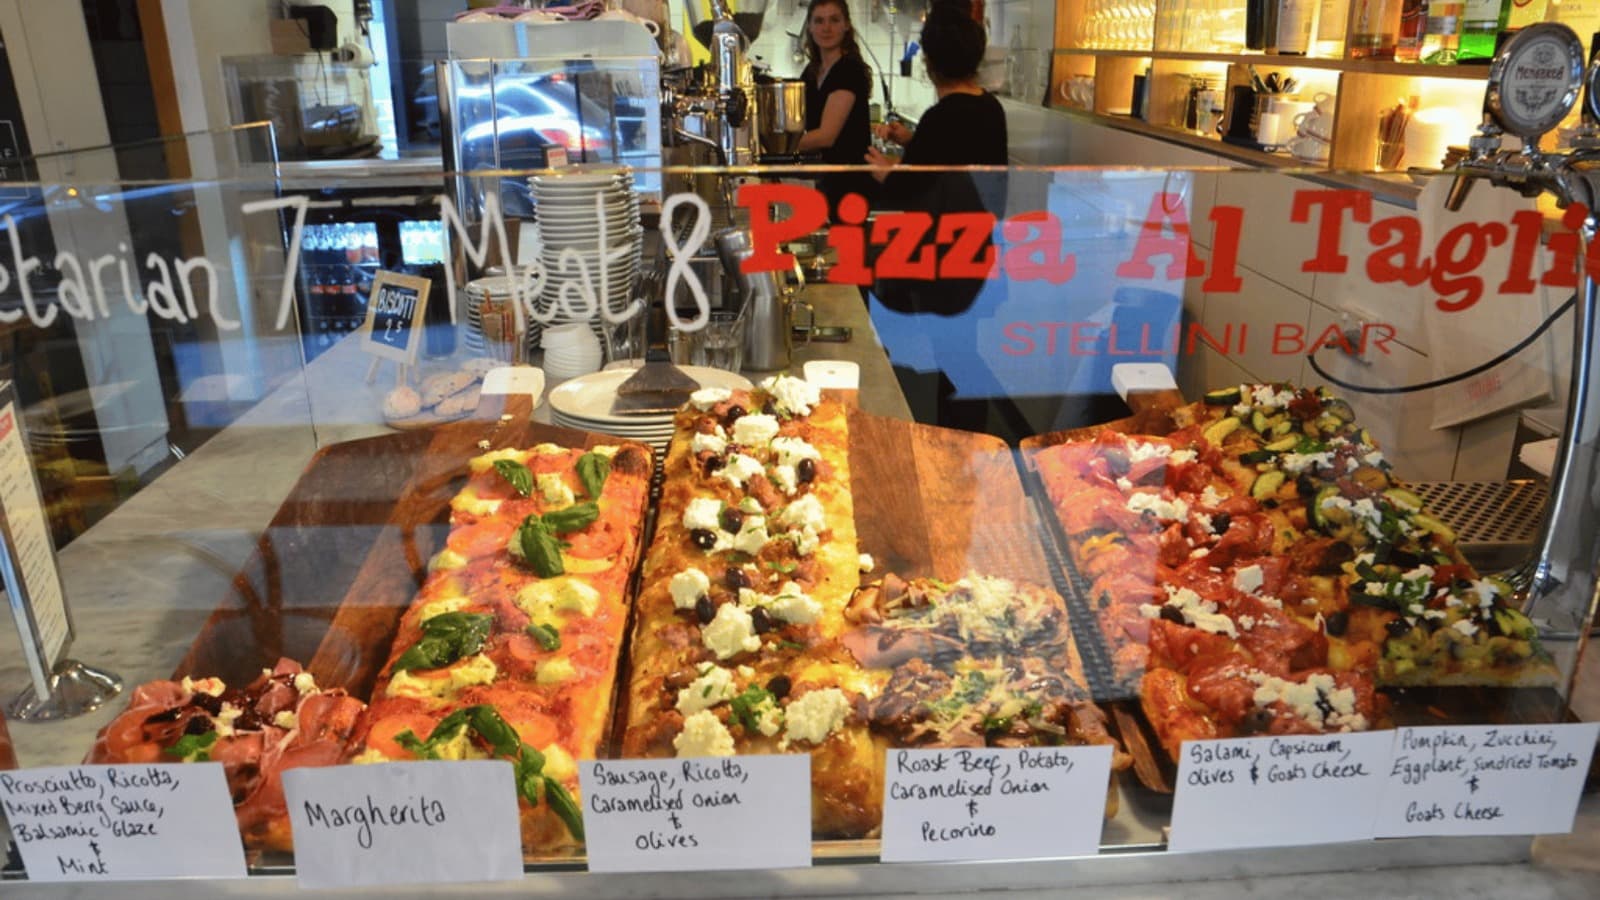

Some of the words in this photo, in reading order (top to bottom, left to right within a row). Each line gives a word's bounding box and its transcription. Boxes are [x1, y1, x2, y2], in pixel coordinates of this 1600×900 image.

[738, 184, 1076, 285] Pizza
[1116, 192, 1244, 294] Al
[1291, 189, 1600, 312] Tagli
[440, 192, 640, 334] Meat
[660, 193, 713, 332] 8
[1002, 322, 1247, 356] STELLINI
[1272, 322, 1397, 356] BAR
[1190, 742, 1260, 764] Salami,
[1269, 738, 1352, 762] Capsicum,
[1402, 728, 1476, 753] Pumpkin,
[1483, 729, 1558, 750] Zucchini,
[593, 762, 676, 794] Sausage,
[682, 759, 749, 783] Ricotta,
[897, 752, 950, 773] Roast
[954, 750, 1011, 779] Beef,
[1018, 750, 1074, 773] Potato,
[1267, 763, 1307, 783] Goats
[1311, 761, 1371, 778] Cheese
[1389, 756, 1471, 785] Eggplant,
[1536, 753, 1579, 769] Tomato
[1, 769, 105, 798] Prosciutto,
[107, 767, 180, 791] Ricotta,
[890, 778, 992, 800] Caramelised
[1000, 779, 1050, 795] Onion
[5, 797, 57, 816] Mixed
[59, 796, 111, 828] Berry
[111, 795, 164, 818] Sauce,
[304, 794, 446, 849] Margherita
[1405, 801, 1446, 823] Goats
[1453, 802, 1505, 820] Cheese
[13, 821, 99, 842] Balsamic
[112, 820, 158, 837] Glaze
[921, 821, 996, 842] Pecorino
[57, 854, 110, 875] Mint
